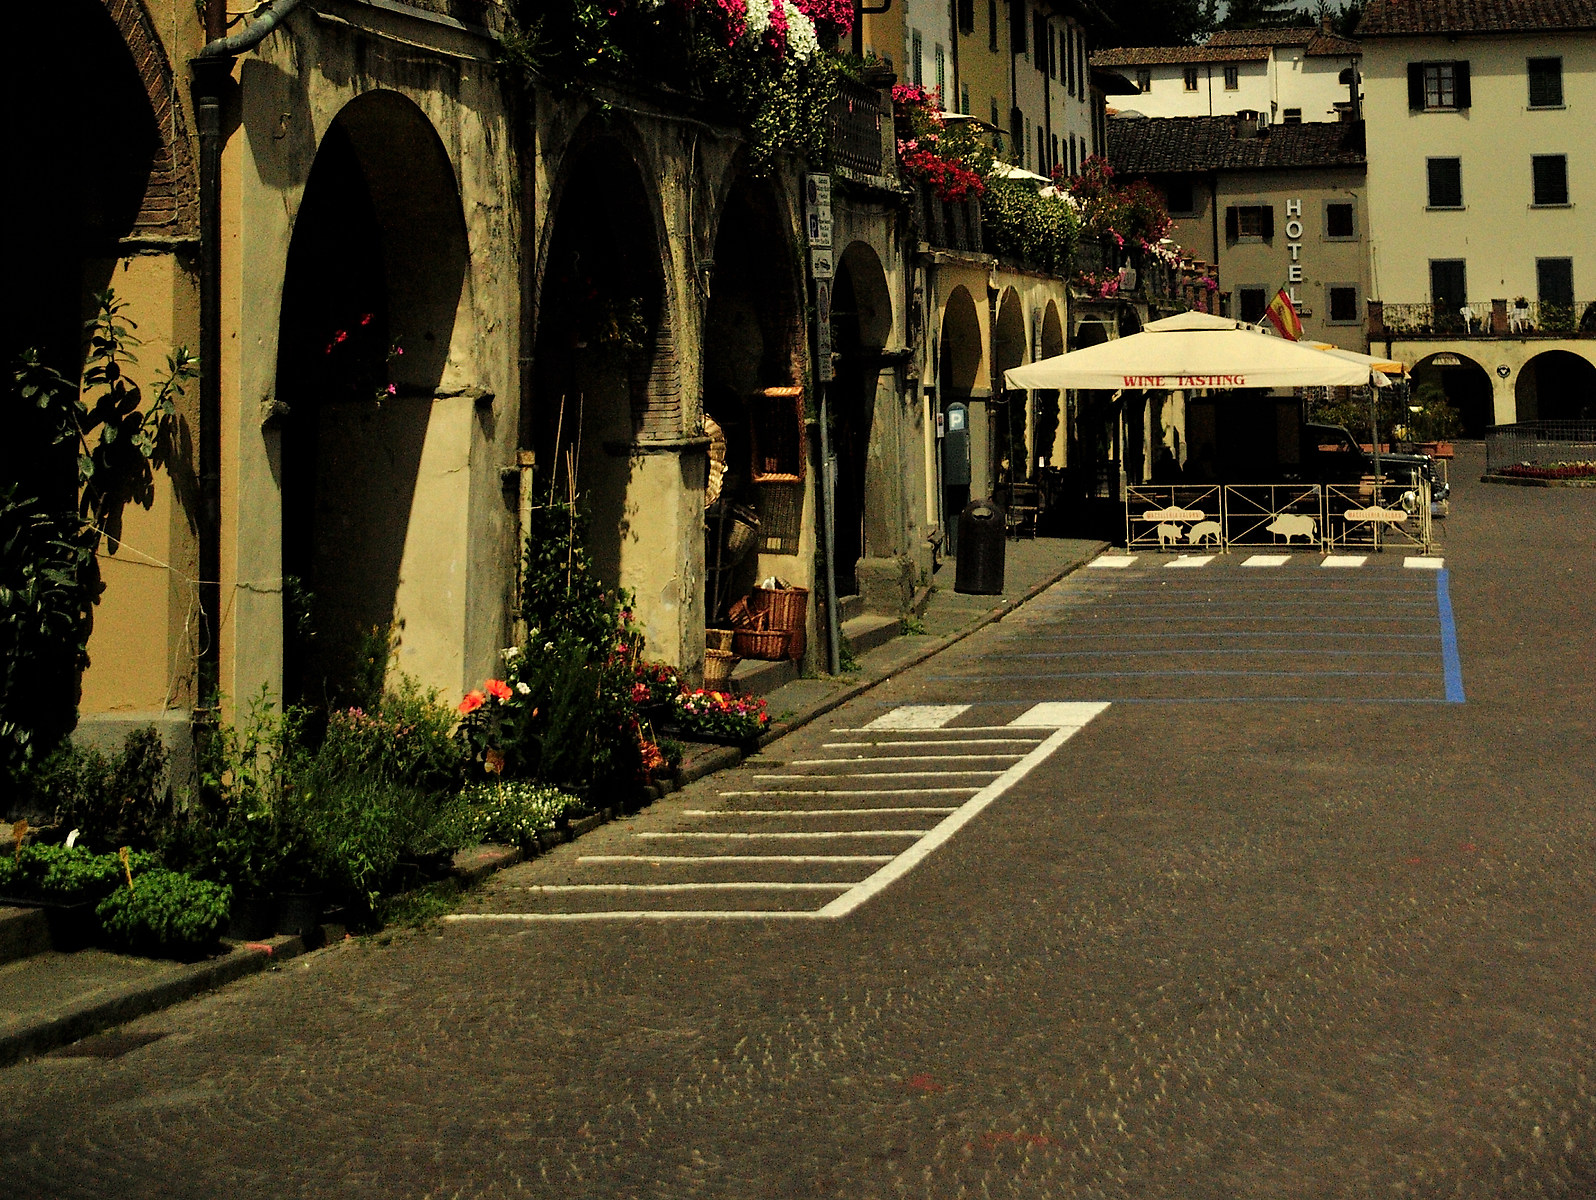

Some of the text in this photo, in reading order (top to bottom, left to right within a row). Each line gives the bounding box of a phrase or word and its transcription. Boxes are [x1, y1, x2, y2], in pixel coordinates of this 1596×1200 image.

[1286, 199, 1303, 304] HOTEL
[1123, 375, 1245, 387] WINE TASTING
[951, 413, 962, 427] P
